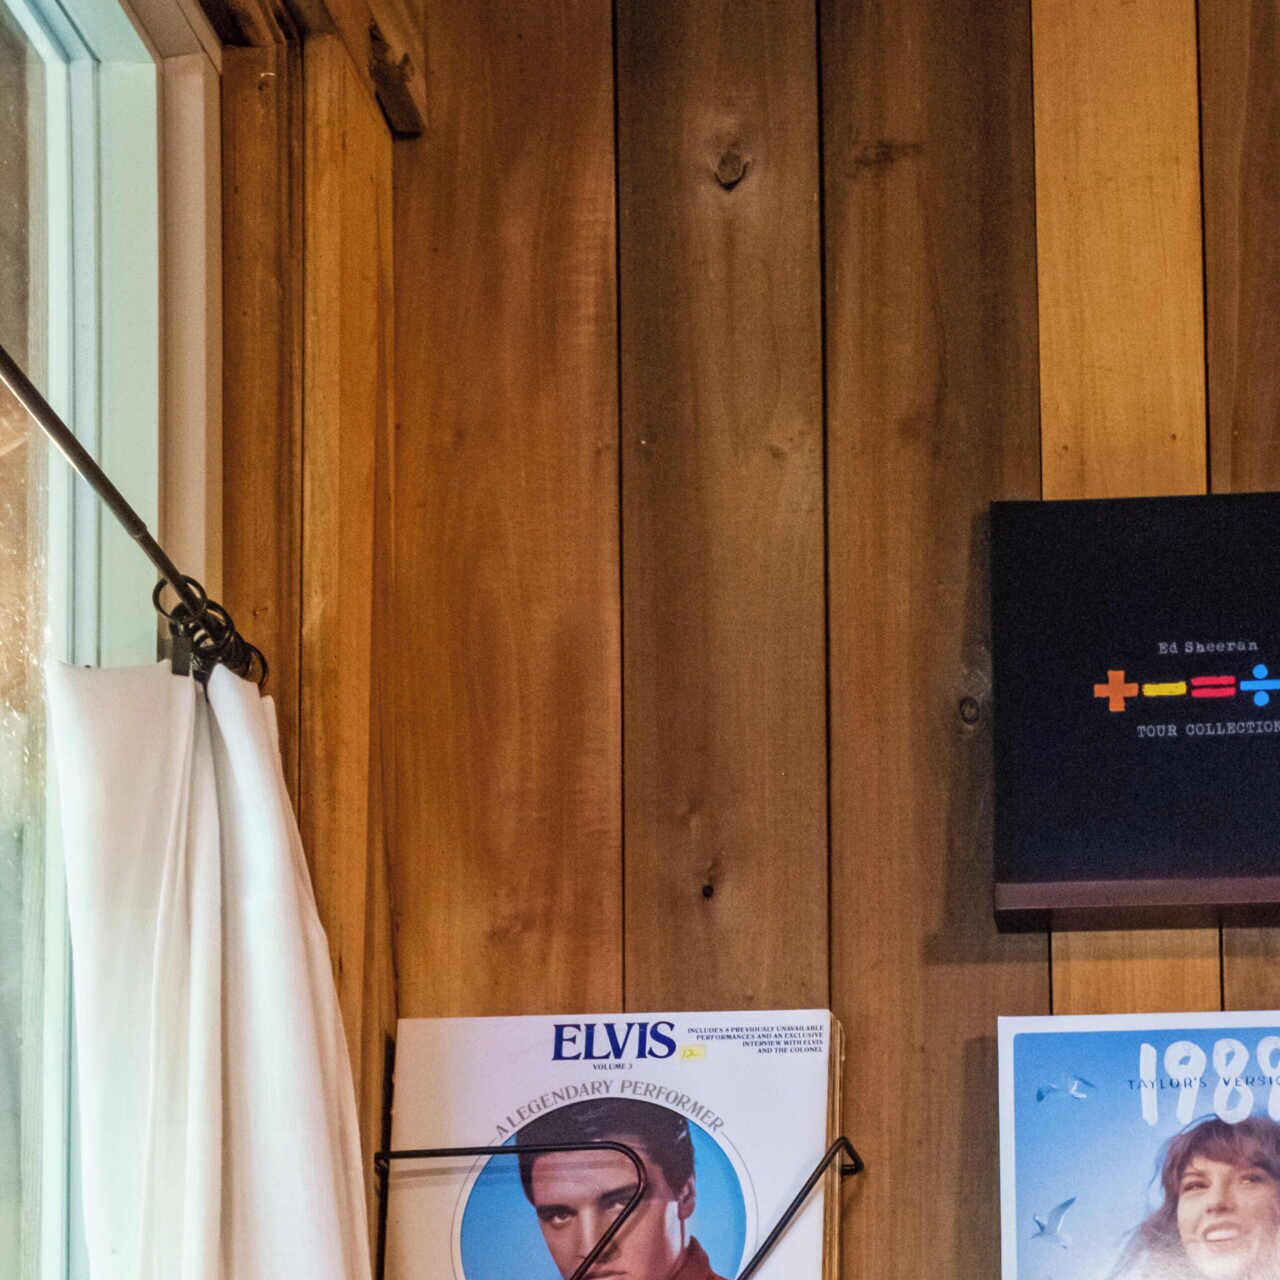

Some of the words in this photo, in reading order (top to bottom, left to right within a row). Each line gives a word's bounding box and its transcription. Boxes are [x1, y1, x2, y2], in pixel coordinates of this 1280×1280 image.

[1158, 642, 1178, 654] Ed
[1185, 640, 1258, 653] Sheeran
[1137, 725, 1177, 737] TOUR
[552, 1021, 677, 1061] ELVIS
[592, 1063, 626, 1071] VOLUME
[1127, 1078, 1208, 1091] TAYLOR'S
[495, 1125, 509, 1139] A
[505, 1080, 615, 1129] LEGENDARY
[620, 1079, 725, 1132] PERFORMER
